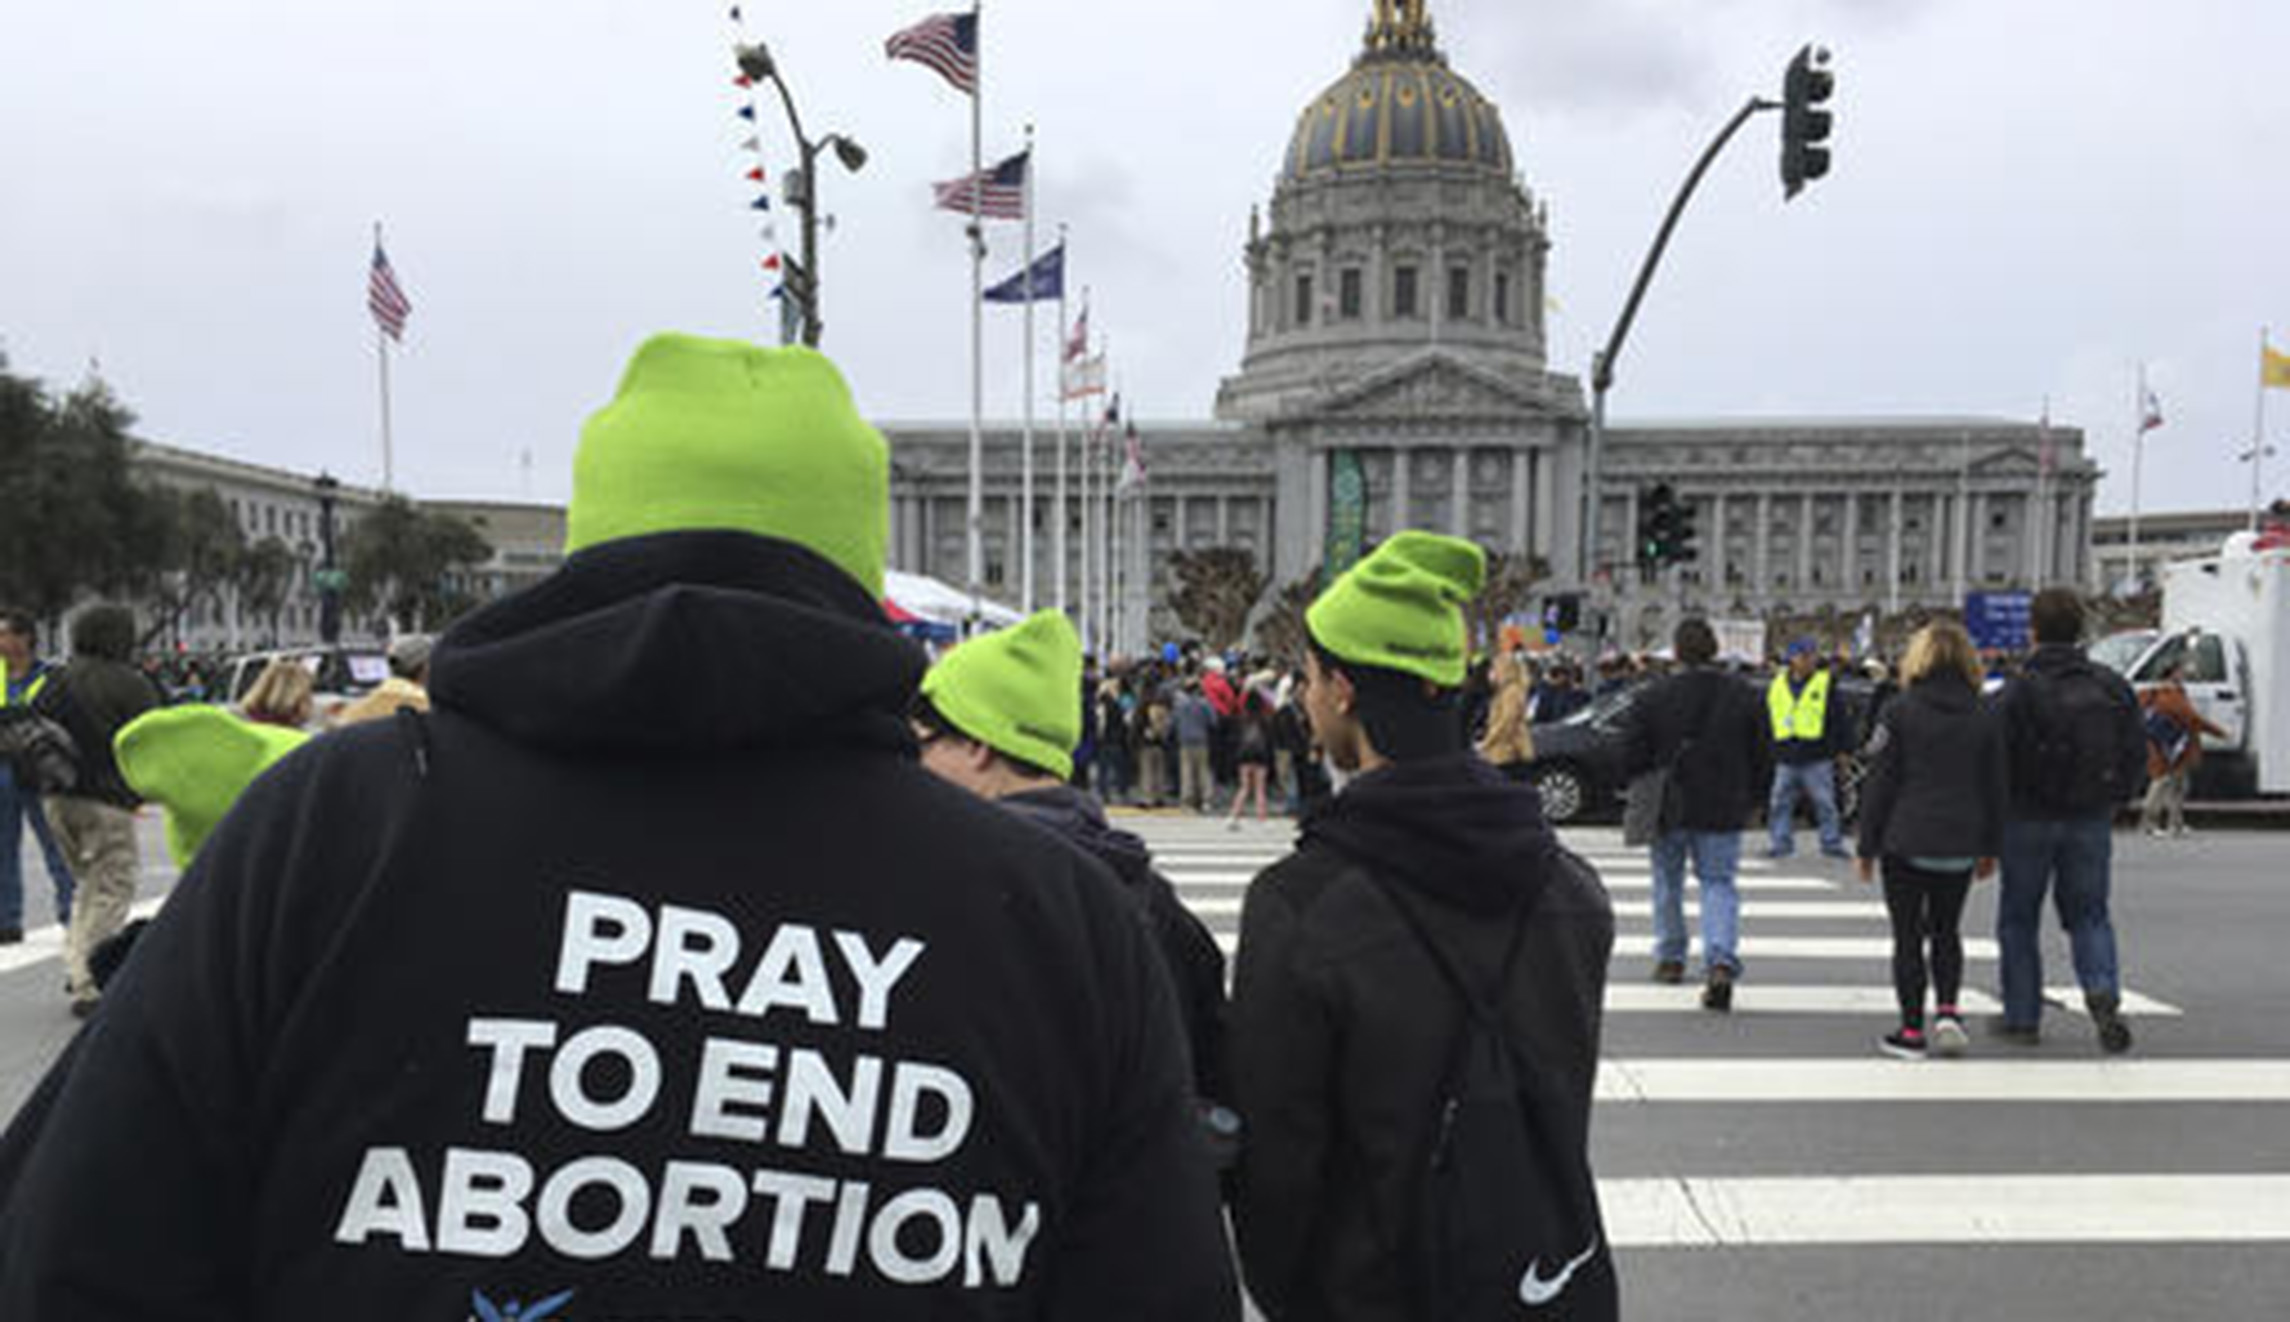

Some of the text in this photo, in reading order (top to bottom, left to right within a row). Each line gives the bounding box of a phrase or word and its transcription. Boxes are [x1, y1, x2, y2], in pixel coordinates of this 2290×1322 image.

[555, 890, 925, 1029] PRAY
[467, 1018, 974, 1162] TO END
[335, 1147, 1040, 1288] ABORTION
